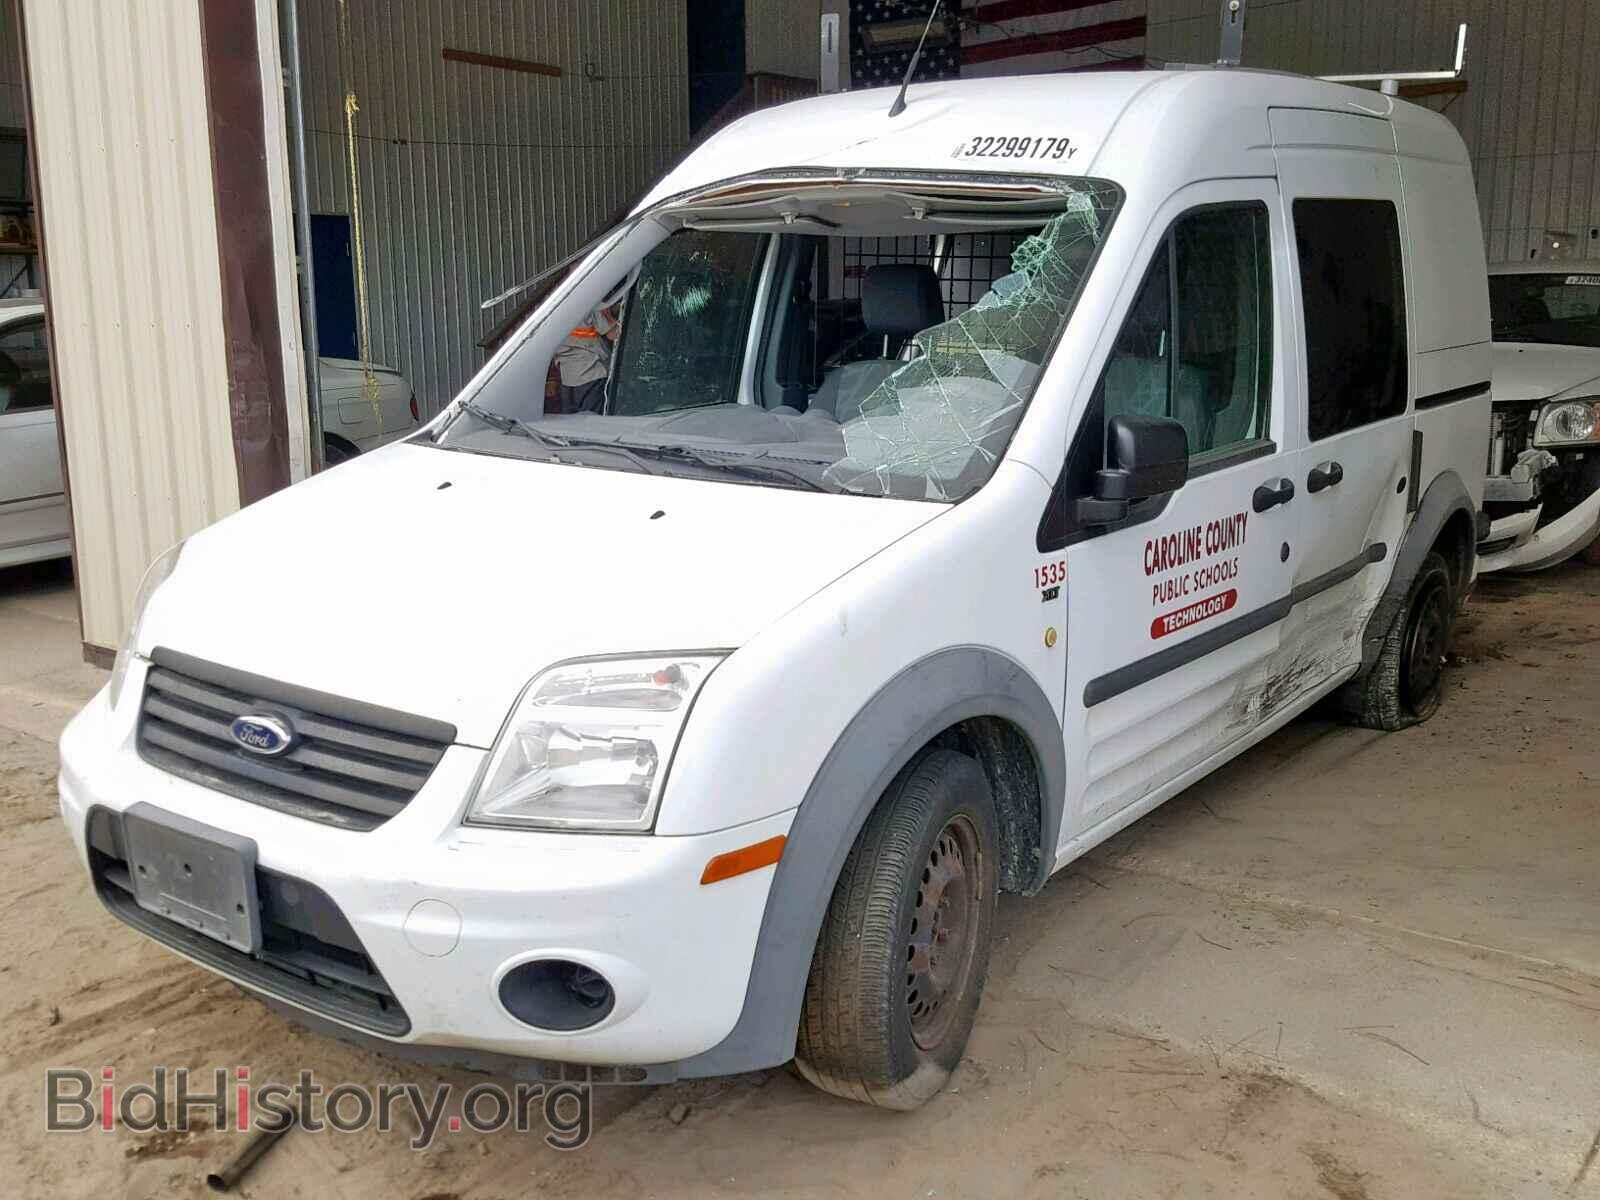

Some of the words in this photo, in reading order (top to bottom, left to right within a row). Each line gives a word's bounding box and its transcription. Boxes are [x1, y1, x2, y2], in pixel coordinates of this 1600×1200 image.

[1144, 526, 1202, 576] CAROLINE
[1205, 512, 1249, 556] COUNTY
[1034, 560, 1066, 588] 1535
[1152, 576, 1189, 606] PUBLIC
[1193, 557, 1239, 592] SCHOOLS
[1162, 594, 1227, 632] TECHNOLOGY
[240, 723, 270, 747] Ford
